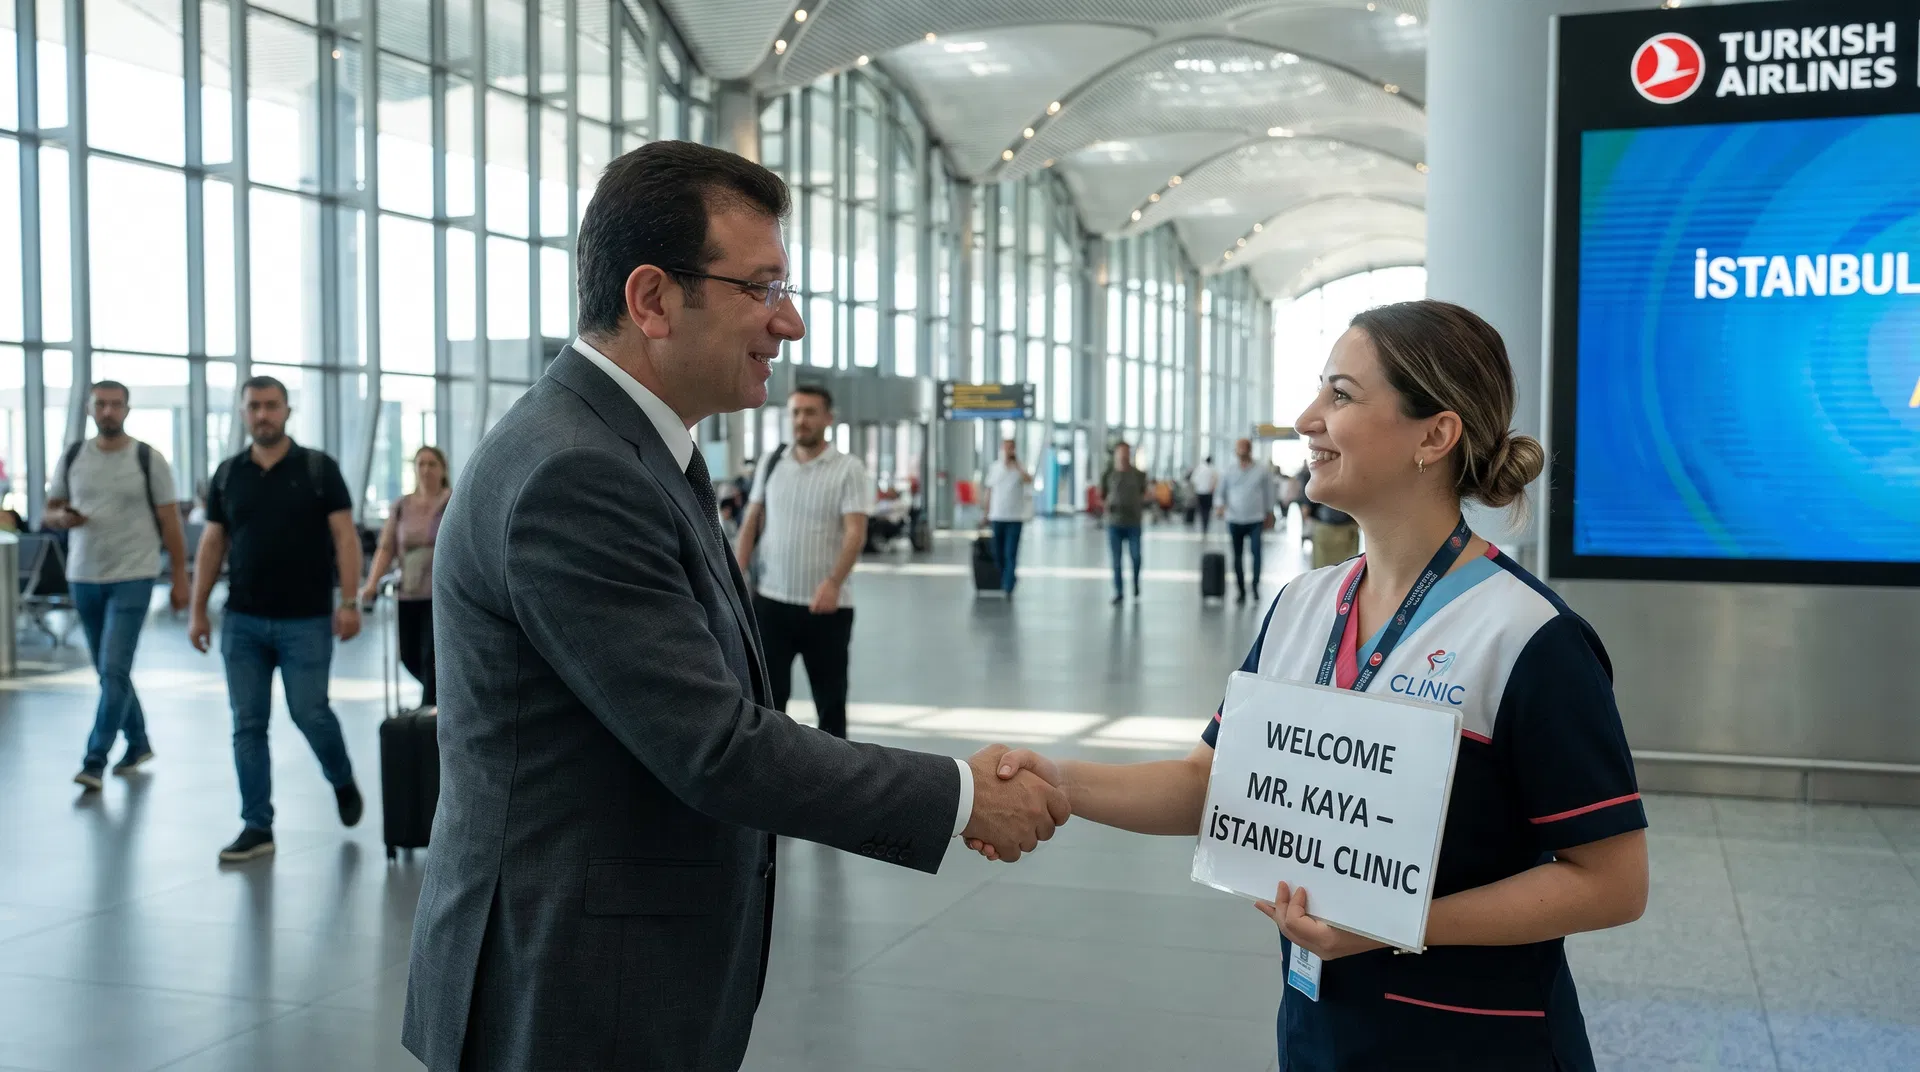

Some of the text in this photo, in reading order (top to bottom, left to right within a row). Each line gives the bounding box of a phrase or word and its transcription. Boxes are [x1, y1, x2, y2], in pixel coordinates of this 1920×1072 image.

[1718, 21, 1896, 64] TURKISH
[1715, 56, 1897, 98] AIRLINES
[1694, 248, 1920, 299] İSTANBUL
[1390, 674, 1466, 706] CLINIC
[1267, 720, 1397, 775] WELCOME
[1246, 771, 1293, 809] MR.
[1300, 784, 1369, 828] KAYA
[1209, 804, 1421, 895] İSTANBUL CLINIC
